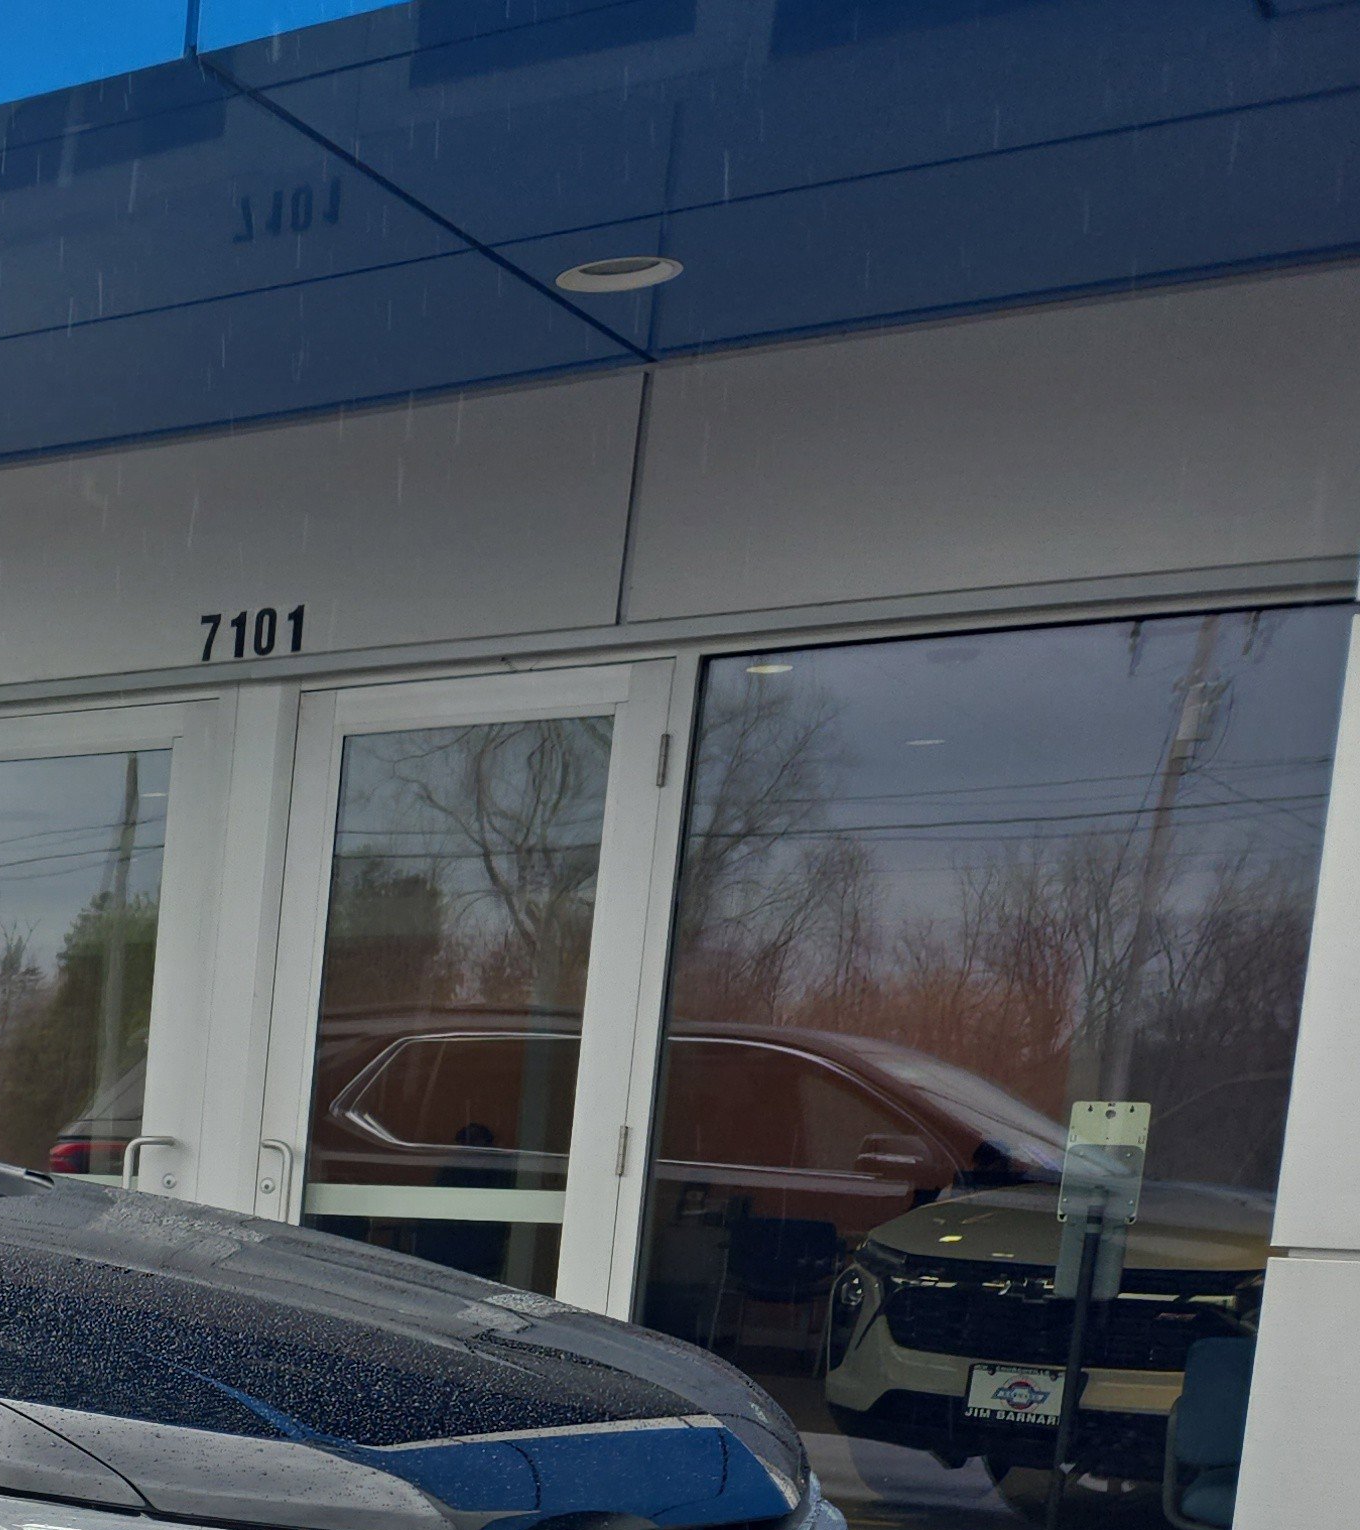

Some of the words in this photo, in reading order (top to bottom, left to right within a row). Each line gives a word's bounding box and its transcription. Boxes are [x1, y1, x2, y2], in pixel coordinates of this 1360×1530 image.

[200, 603, 306, 662] 7101
[964, 1407, 990, 1419] JIM
[997, 1411, 1060, 1426] BARNAR
